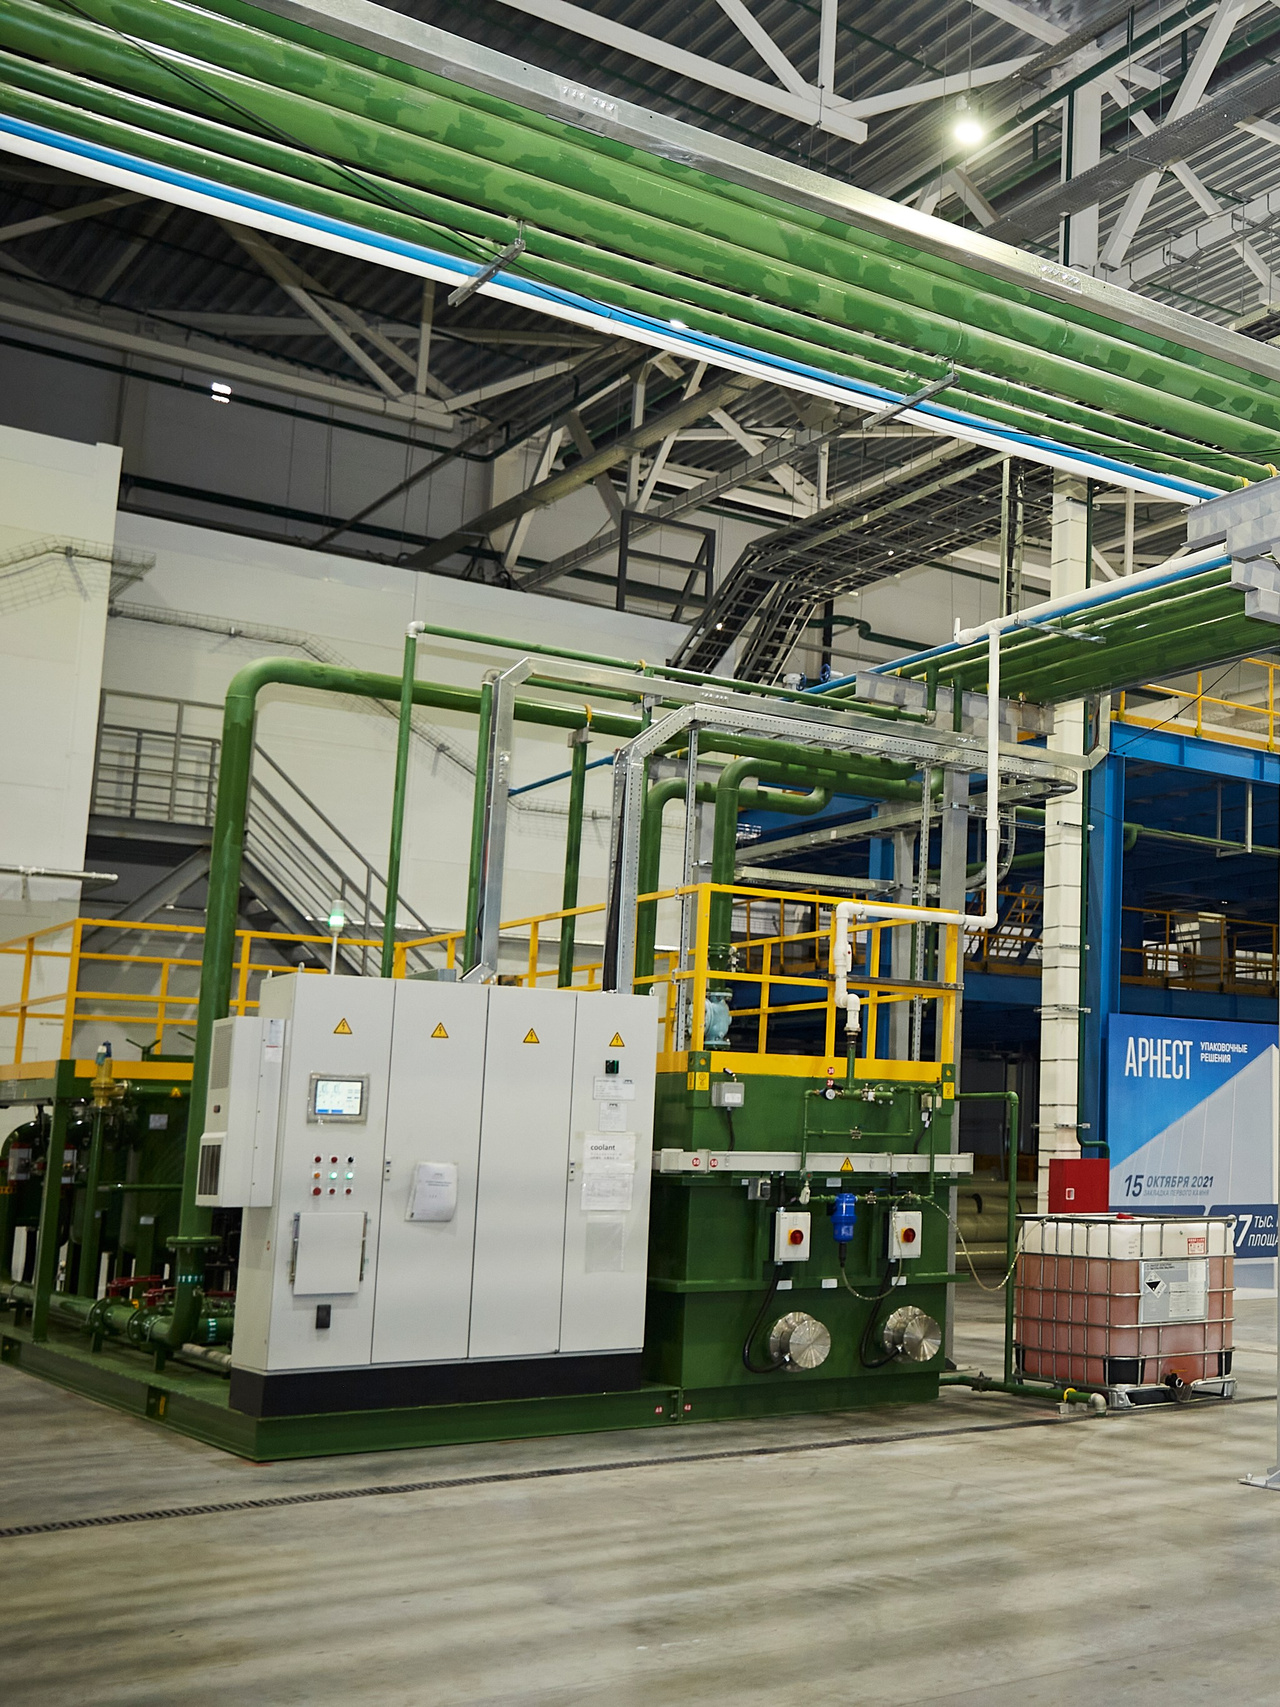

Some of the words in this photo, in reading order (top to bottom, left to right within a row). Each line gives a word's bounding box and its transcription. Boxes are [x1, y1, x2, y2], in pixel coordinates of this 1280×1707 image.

[1200, 1041, 1248, 1053] УПАКОВОЧНЫЕ
[1124, 1036, 1194, 1080] АРНЕСТ
[1200, 1053, 1231, 1063] РЕШЕНИЯ
[1124, 1174, 1144, 1197] 15
[1146, 1176, 1190, 1188] ОКТЯБРЯ
[1191, 1175, 1214, 1188] 2021
[1254, 1214, 1274, 1228] ТЫС.
